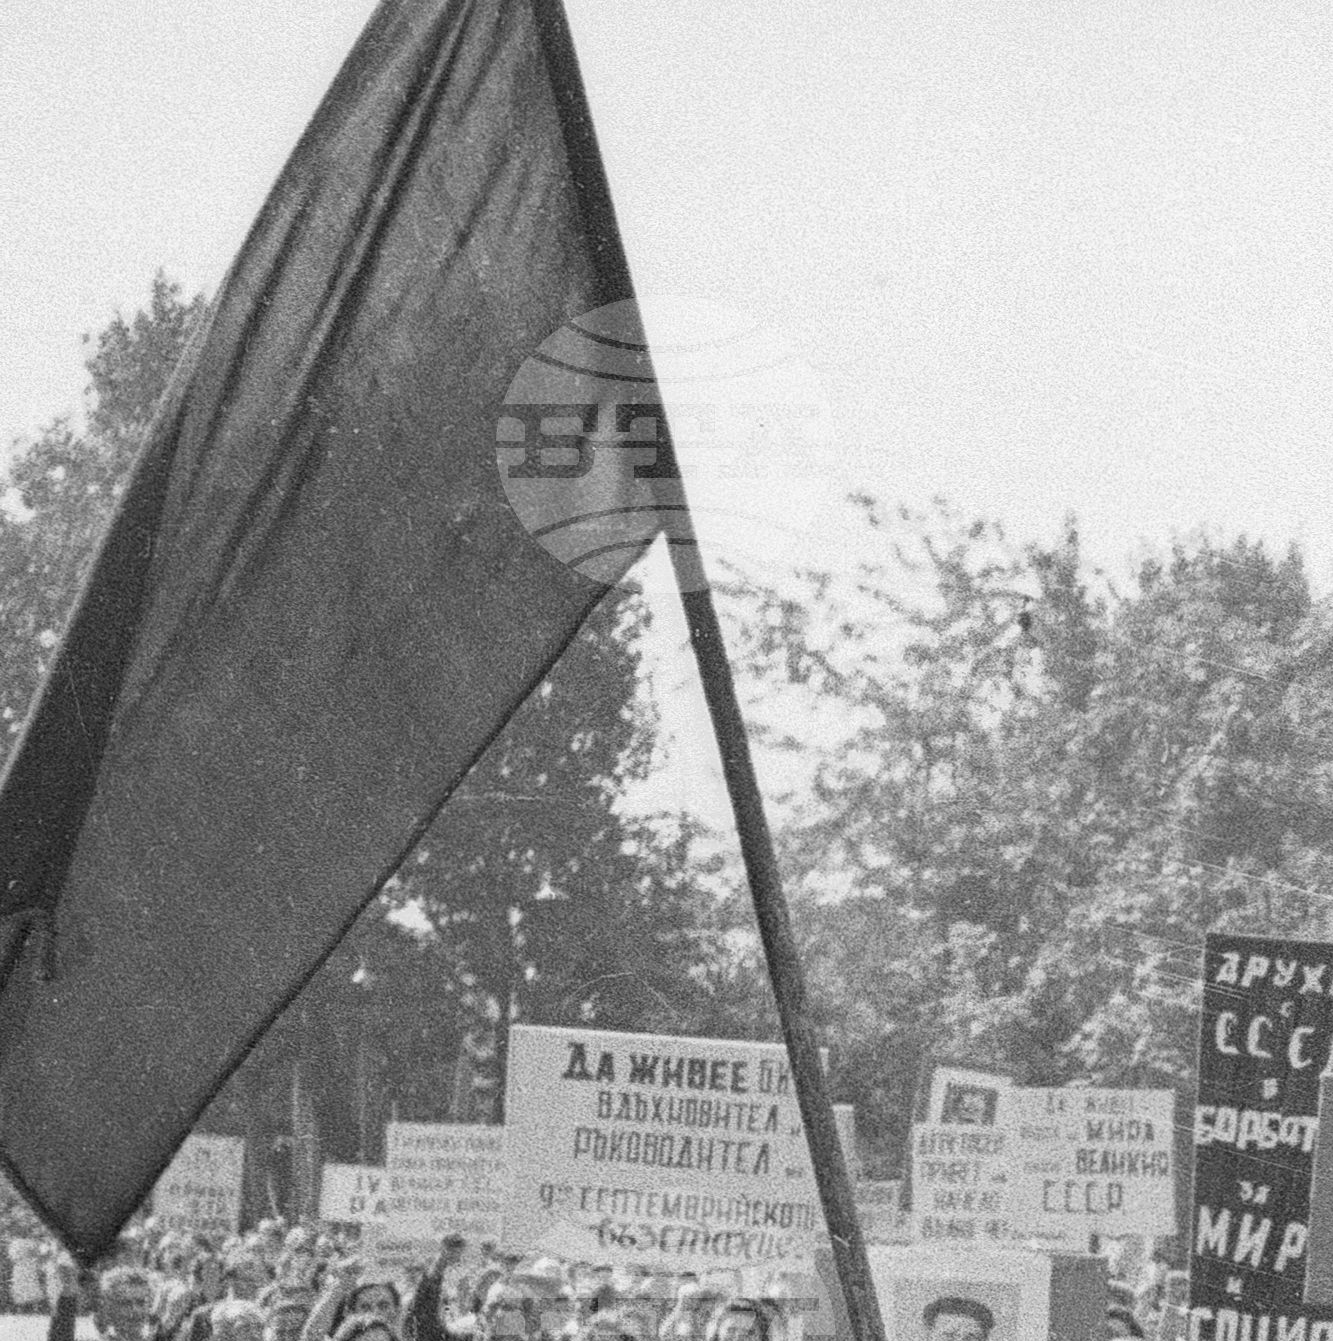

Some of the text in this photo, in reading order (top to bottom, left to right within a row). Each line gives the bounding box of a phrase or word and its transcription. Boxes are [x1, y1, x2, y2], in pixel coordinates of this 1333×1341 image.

[561, 1040, 617, 1083] ДА
[626, 1052, 750, 1095] ЖИВЕЕ
[1042, 1178, 1125, 1214] СССР
[1197, 1204, 1308, 1272] МИР
